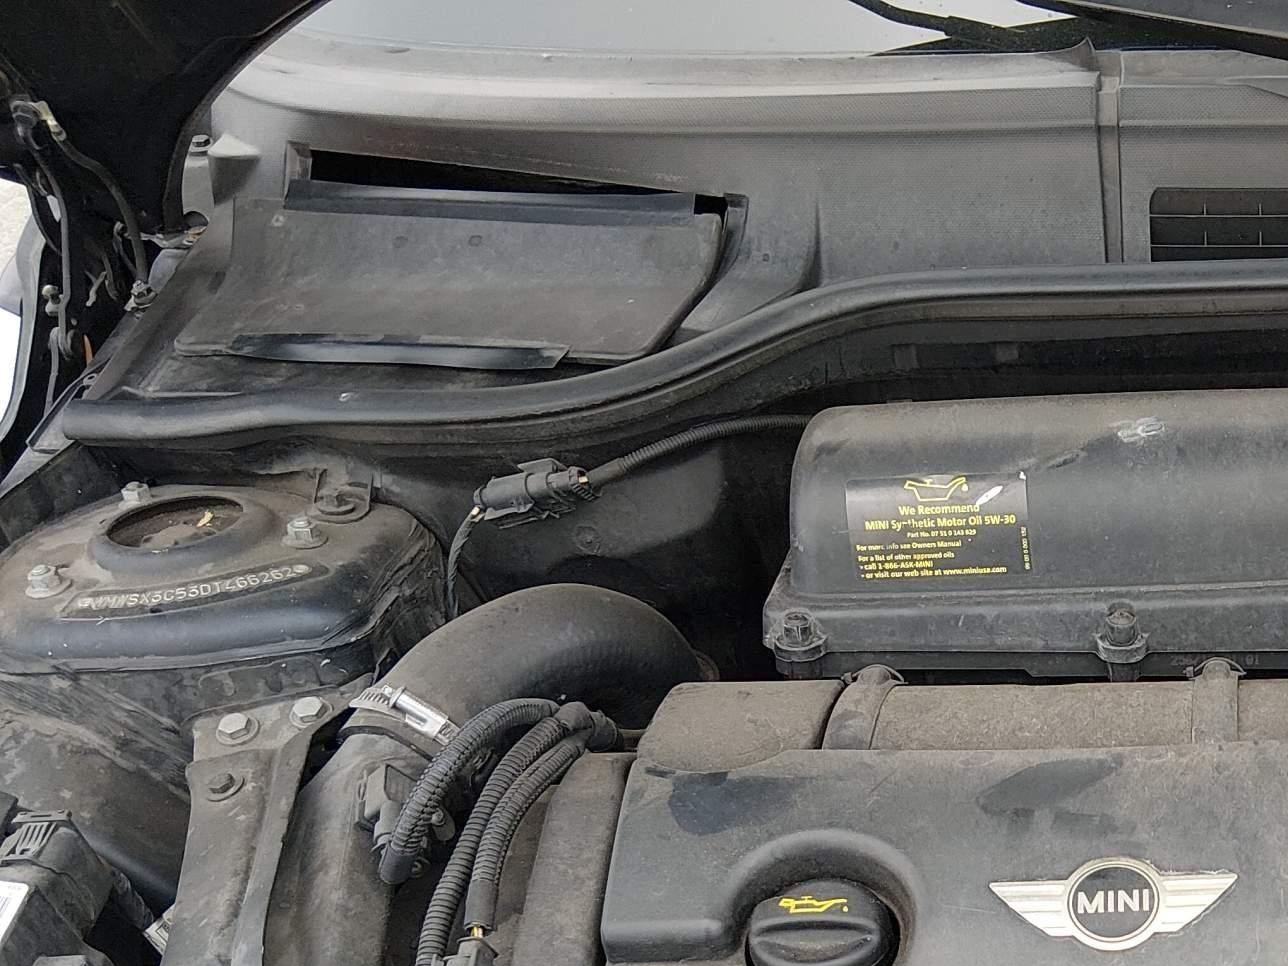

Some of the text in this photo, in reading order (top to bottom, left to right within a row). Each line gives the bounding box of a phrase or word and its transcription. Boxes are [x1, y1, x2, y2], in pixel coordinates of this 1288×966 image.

[898, 505, 916, 515] We
[864, 520, 889, 530] MINI
[937, 518, 967, 527] Motor
[968, 515, 982, 525] Oil
[984, 514, 1016, 525] 5W-30
[943, 566, 1007, 575] www.miniusa.com
[1077, 888, 1150, 914] MINI
